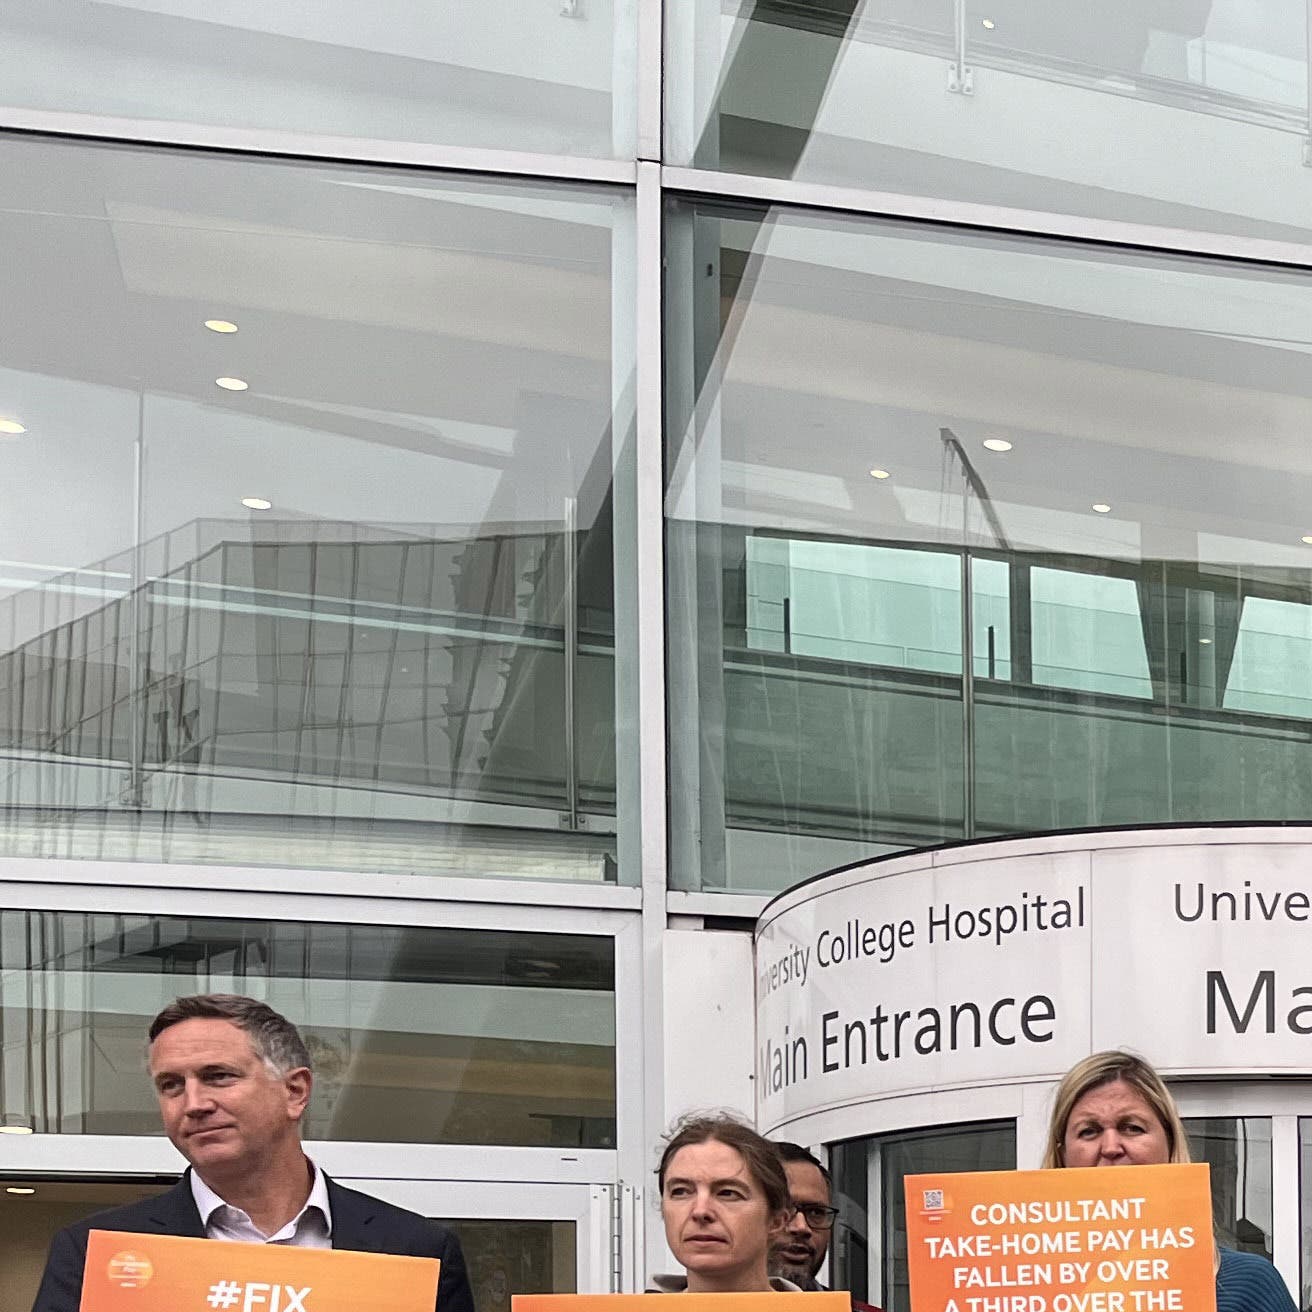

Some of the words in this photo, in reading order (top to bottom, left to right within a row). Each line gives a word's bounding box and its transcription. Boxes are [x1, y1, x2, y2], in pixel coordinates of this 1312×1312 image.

[759, 944, 809, 997] versity
[817, 919, 914, 967] College
[929, 886, 1083, 945] Hospital
[761, 1025, 807, 1098] Main
[822, 995, 1056, 1073] Entrance
[971, 1198, 1145, 1225] CONSULTANT
[925, 1232, 1081, 1258] TAKE-HOME
[1088, 1230, 1134, 1251] PAY
[1141, 1227, 1194, 1249] HAS
[954, 1264, 1052, 1288] FALLEN
[1060, 1262, 1090, 1283] BY
[1098, 1259, 1168, 1282] OVER
[1130, 1290, 1183, 1311] THE
